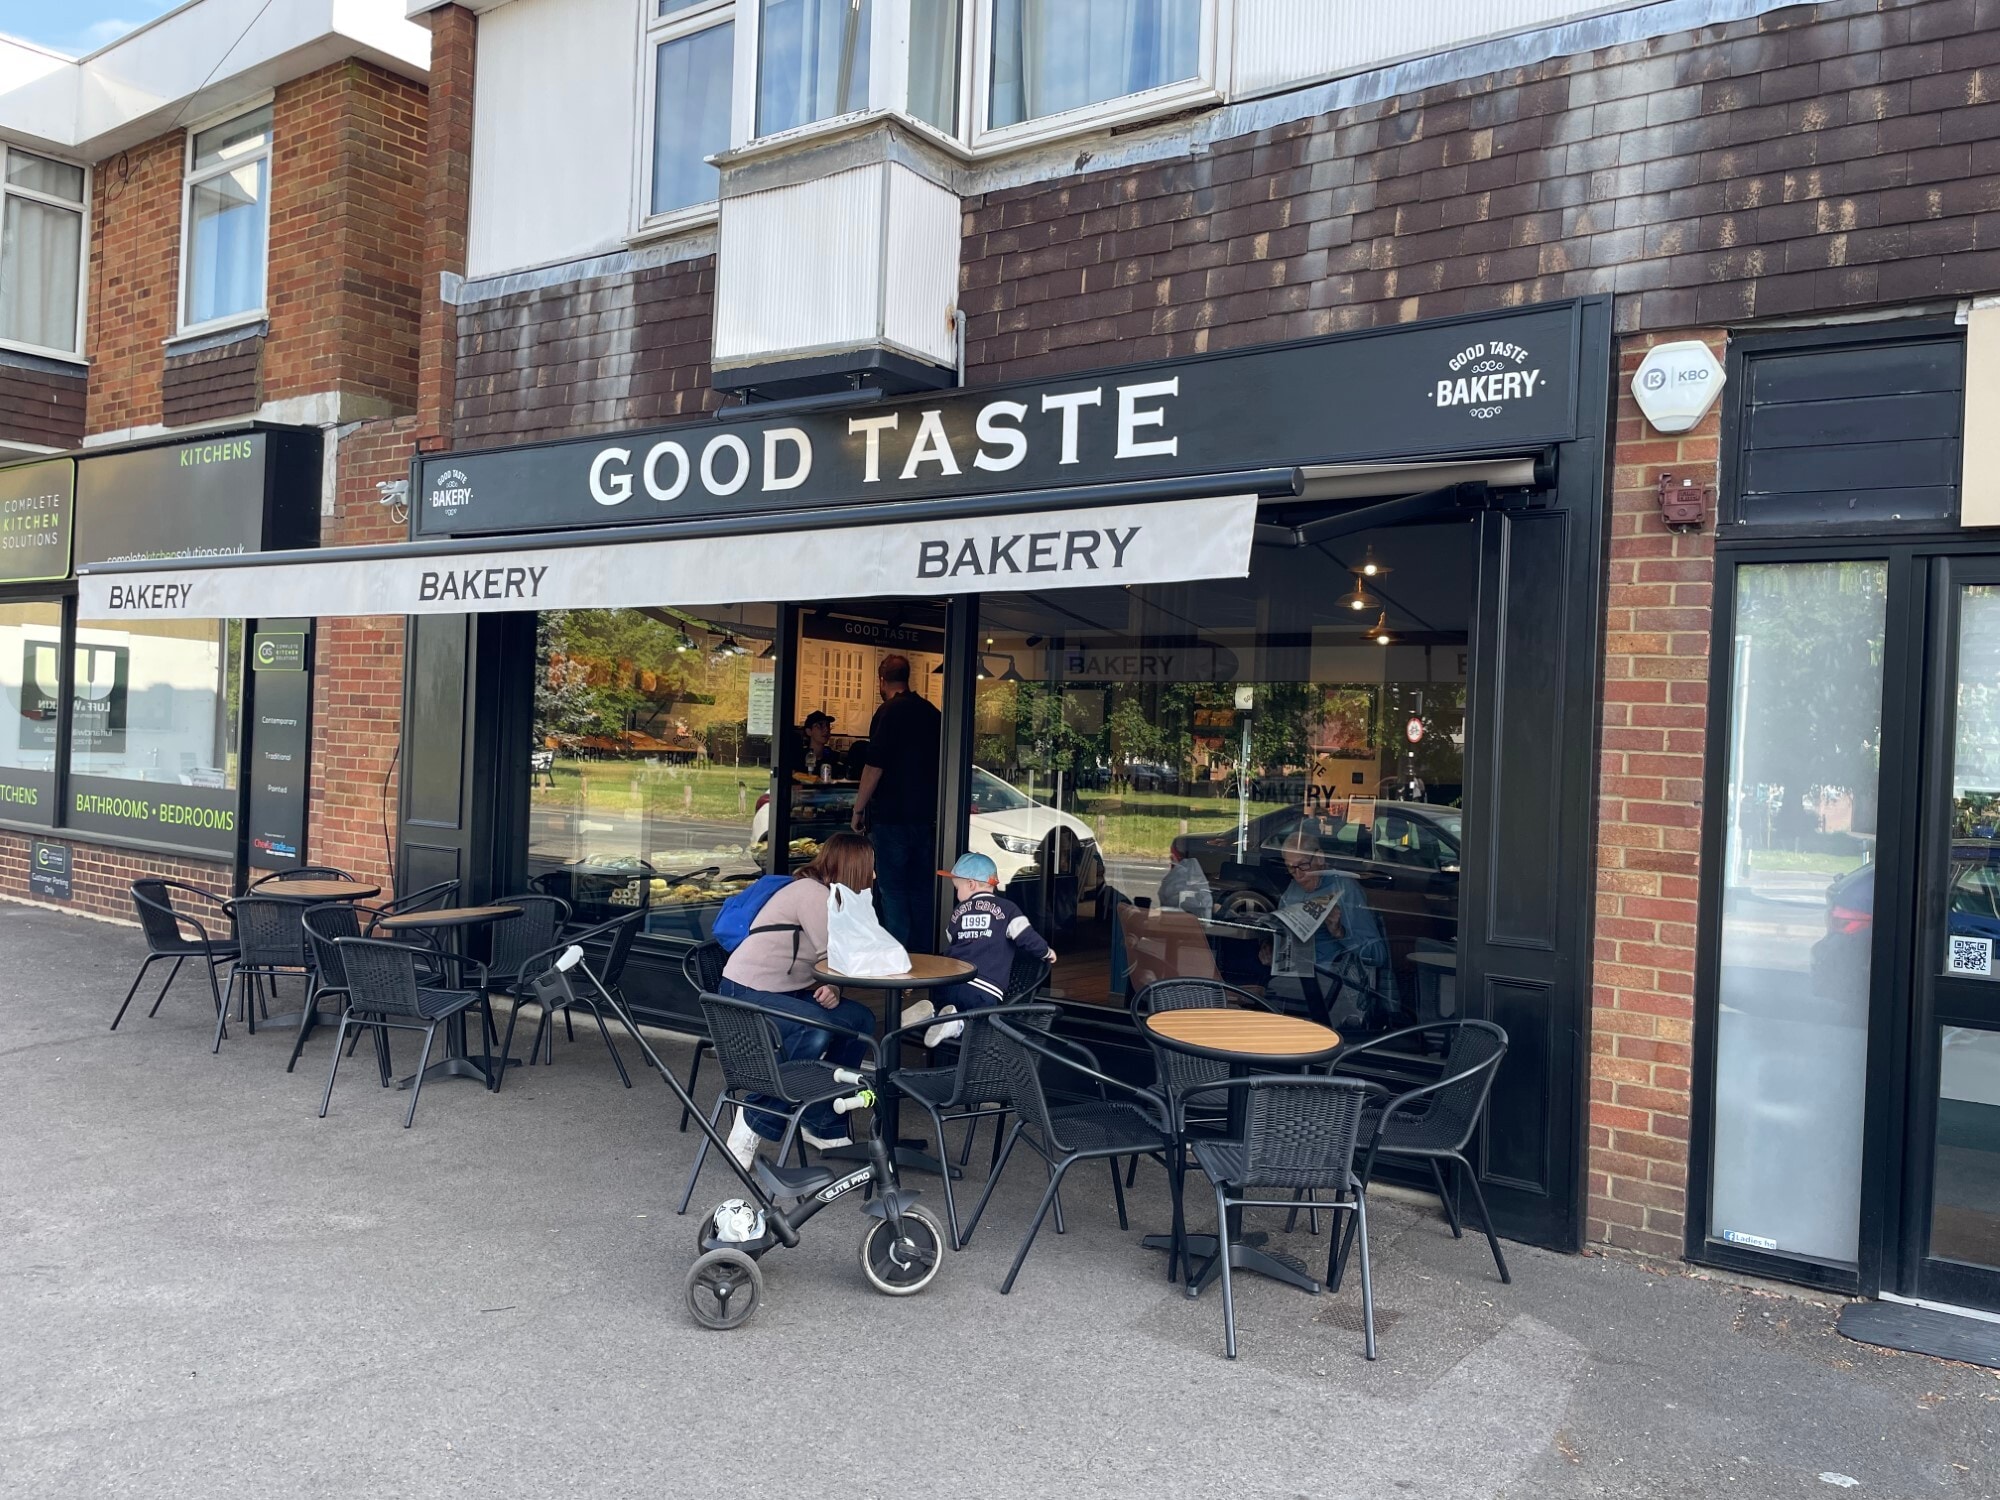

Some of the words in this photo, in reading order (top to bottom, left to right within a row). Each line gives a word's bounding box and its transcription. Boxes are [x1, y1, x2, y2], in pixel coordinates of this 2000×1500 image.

[1449, 343, 1485, 371] GOOD
[1490, 341, 1529, 364] TASTE
[1677, 369, 1709, 382] KBO
[1436, 368, 1540, 407] BAKERY
[589, 427, 813, 506] GOOD
[847, 376, 1179, 484] TASTE
[180, 440, 252, 467] KITCHENS
[437, 470, 452, 486] GOOD
[452, 469, 468, 484] TASTE
[4, 494, 60, 513] COMPLETE
[432, 488, 472, 507] BAKERY
[3, 513, 59, 532] KITCHEN
[2, 532, 58, 550] SOLUTIONS
[916, 526, 1142, 578] BAKERY
[418, 565, 548, 601] BAKERY
[108, 583, 193, 609] BAKERY
[845, 622, 879, 637] GOOD
[882, 627, 919, 642] TASTE
[1069, 655, 1174, 675] BAKERY
[262, 716, 297, 727] Contemporary
[265, 752, 291, 761] Traditional
[268, 784, 288, 794] Painted
[76, 793, 149, 820] BATHROOMS
[159, 803, 234, 831] BEDROOMS
[975, 900, 1006, 920] COAST
[964, 916, 988, 927] 1995
[957, 930, 979, 940] SPORTS
[825, 1181, 851, 1199] ELITE
[851, 1171, 870, 1185] PRO
[1736, 1234, 1763, 1246] Ladies
